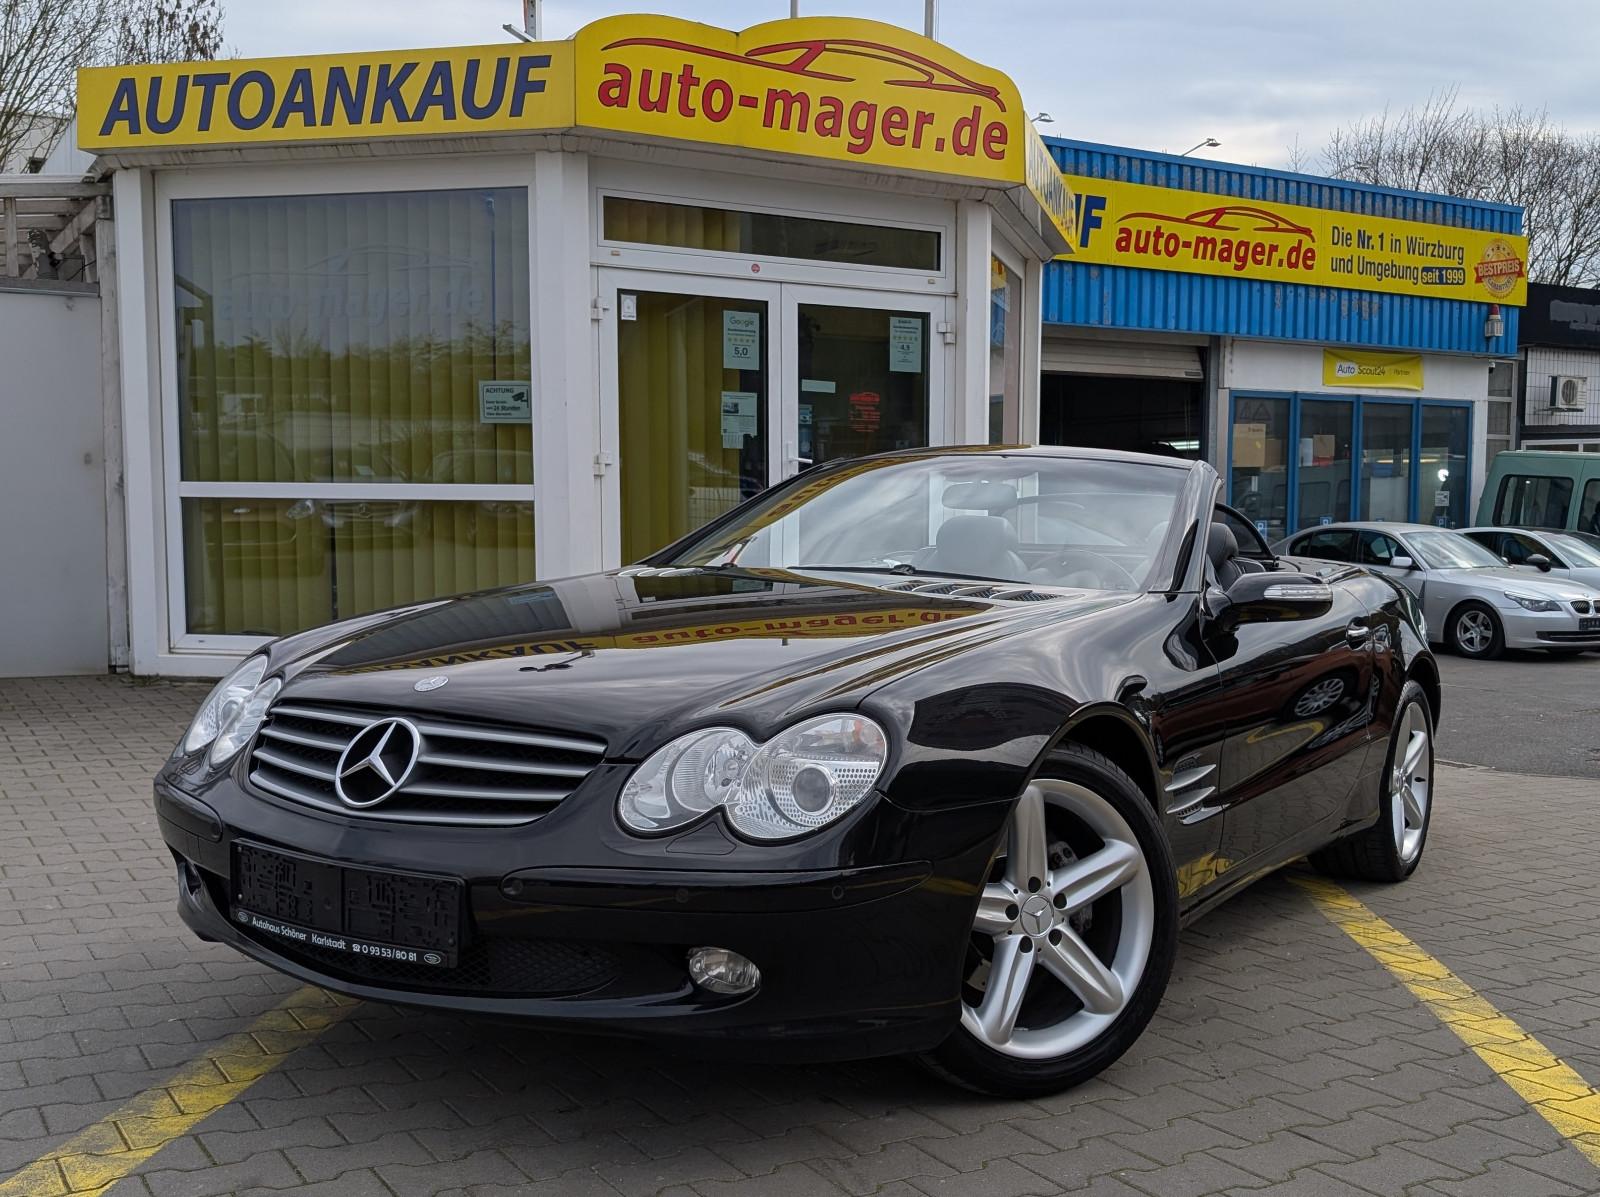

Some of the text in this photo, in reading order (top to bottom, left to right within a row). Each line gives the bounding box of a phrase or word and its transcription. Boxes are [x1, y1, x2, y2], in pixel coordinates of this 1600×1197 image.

[99, 55, 552, 136] AUTOANKAUF
[597, 63, 1009, 160] auto-mager.de
[1115, 225, 1316, 272] auto-mager.de
[1331, 225, 1464, 265] Die Nr. 1 in Würzburg
[1331, 255, 1464, 285] und Umgebung seit 1999
[1478, 260, 1520, 277] BESTPREIS
[734, 346, 748, 356] 5,0
[1337, 364, 1355, 374] Auto
[1357, 366, 1386, 376] Scout24
[251, 916, 281, 934] Autohaus
[281, 926, 307, 942] Schöner
[311, 933, 347, 951] Karlstadt
[369, 946, 380, 956] 93
[408, 952, 417, 962] 81
